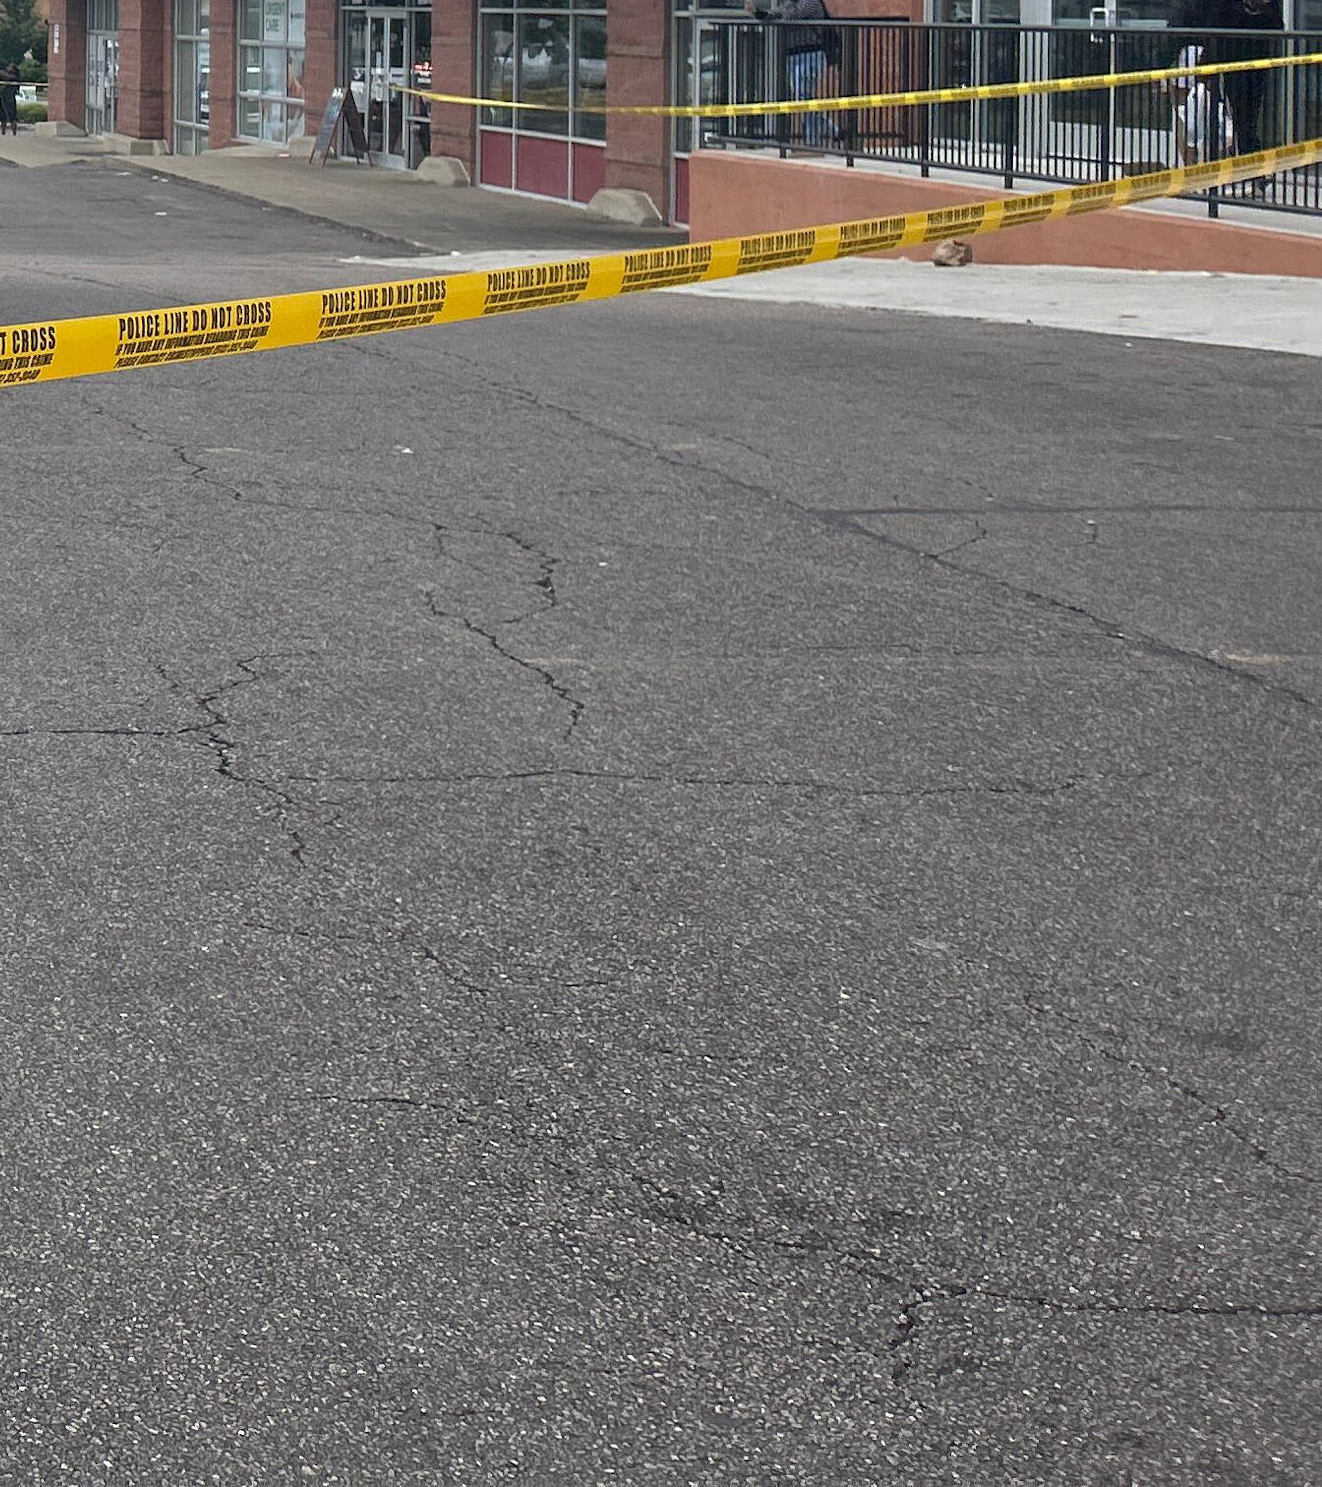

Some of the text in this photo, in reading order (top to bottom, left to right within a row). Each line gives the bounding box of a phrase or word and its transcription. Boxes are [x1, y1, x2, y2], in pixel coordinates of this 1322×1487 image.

[322, 280, 446, 314] POLICE LINE DO NOT CROSS
[118, 315, 159, 341] POLICE
[164, 312, 188, 334] LINE
[192, 309, 207, 331] DO
[211, 307, 232, 329] NOT
[236, 301, 271, 325] CROSS
[12, 326, 55, 354] CROSS
